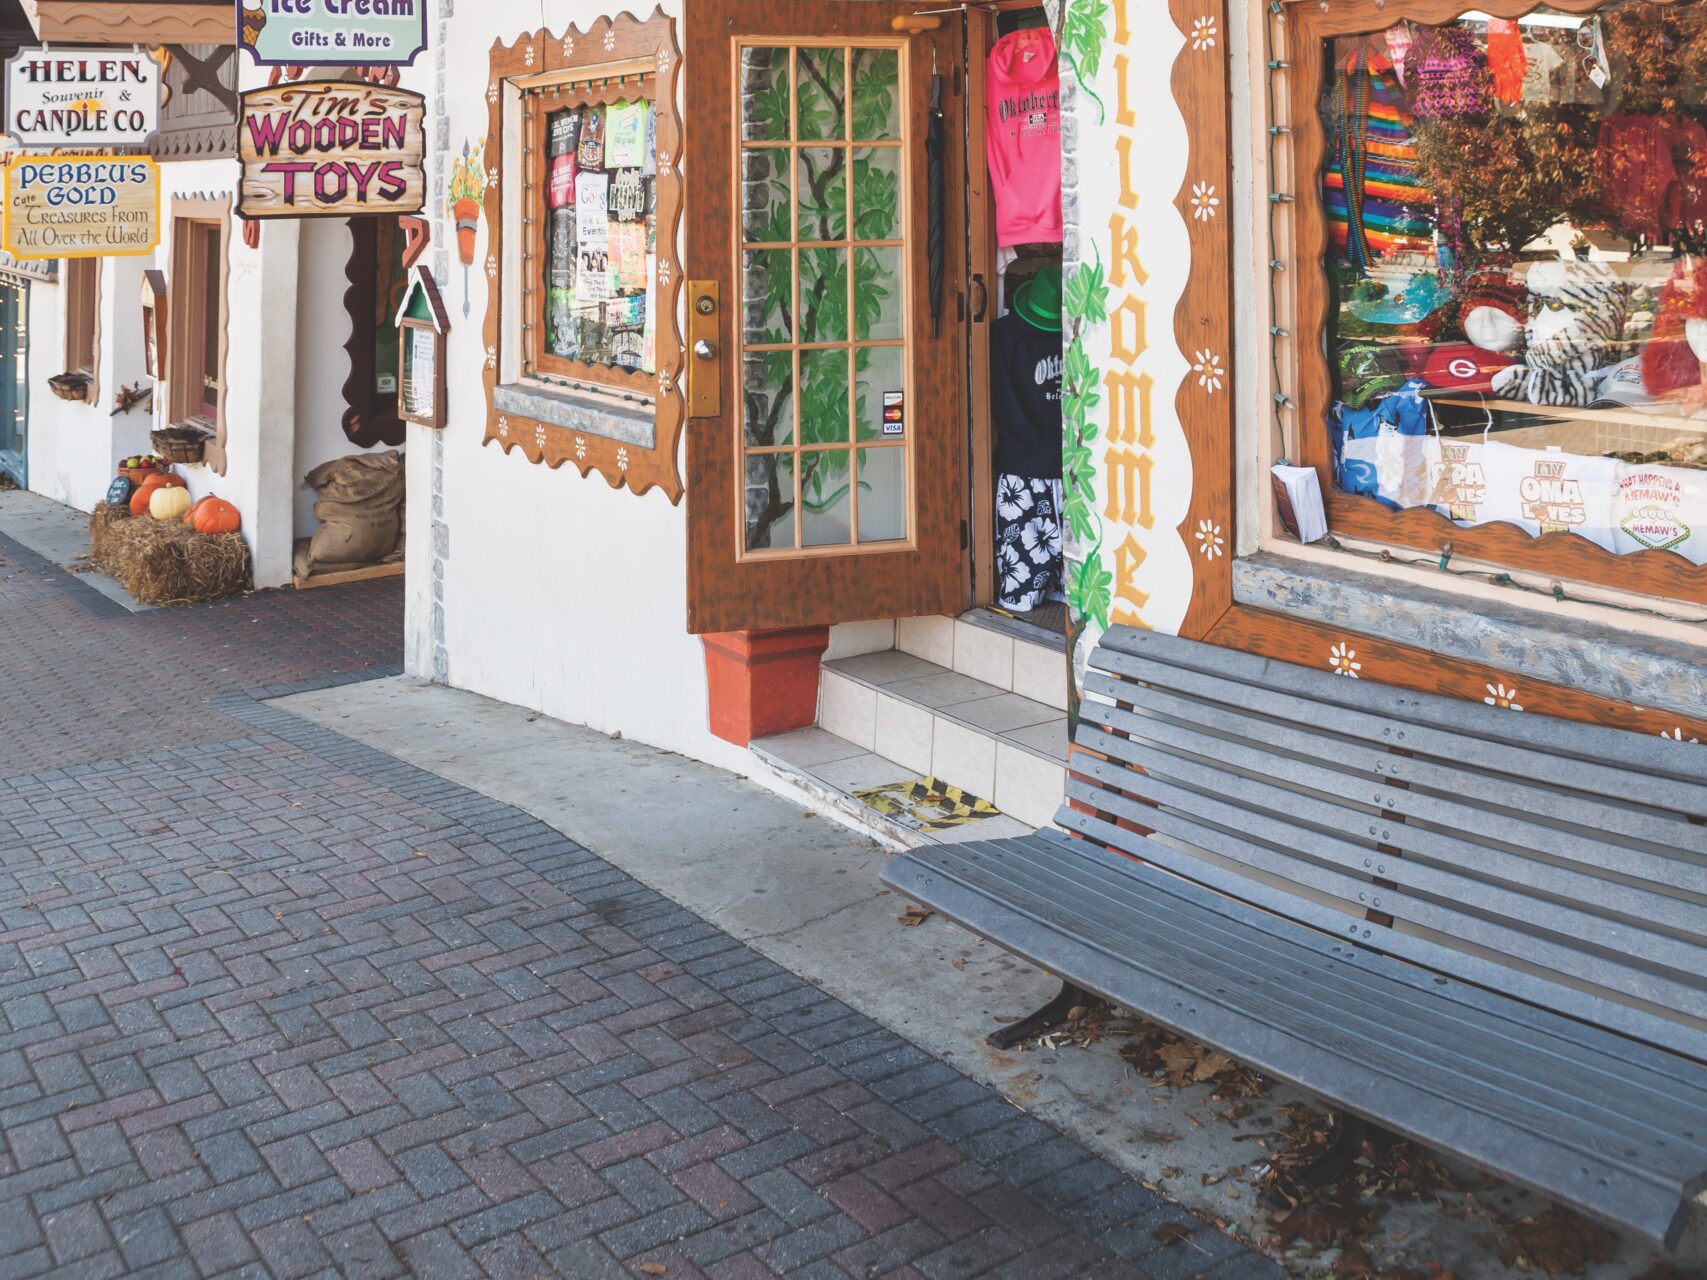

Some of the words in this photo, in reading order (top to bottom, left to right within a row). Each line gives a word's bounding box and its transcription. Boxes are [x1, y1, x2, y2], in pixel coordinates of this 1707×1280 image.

[292, 32, 329, 47] Gifts
[335, 32, 347, 47] &
[353, 33, 391, 47] More
[20, 60, 147, 83] HELEN
[41, 89, 104, 104] Souvenir
[119, 89, 132, 102] &
[281, 86, 389, 121] Tim's
[999, 91, 1057, 123] Oktoberf
[17, 108, 108, 136] CANDLE
[114, 109, 147, 132] CO.
[247, 111, 407, 157] WOODEN
[20, 164, 147, 189] PEBBLU'S
[261, 161, 407, 206] TOYS
[13, 195, 36, 207] Cute
[46, 186, 116, 206] GOLD
[581, 187, 607, 209] Goog
[25, 205, 106, 224] Treasures
[112, 206, 148, 224] From
[18, 227, 38, 247] All
[42, 227, 76, 246] Over
[81, 229, 101, 245] the
[105, 226, 148, 244] World
[1448, 358, 1477, 379] G
[885, 424, 901, 432] VISA
[1536, 462, 1566, 477] MY
[1520, 476, 1584, 505] OMA
[1638, 473, 1673, 490] HAPPENS
[1632, 523, 1678, 537] MEMAW'S
